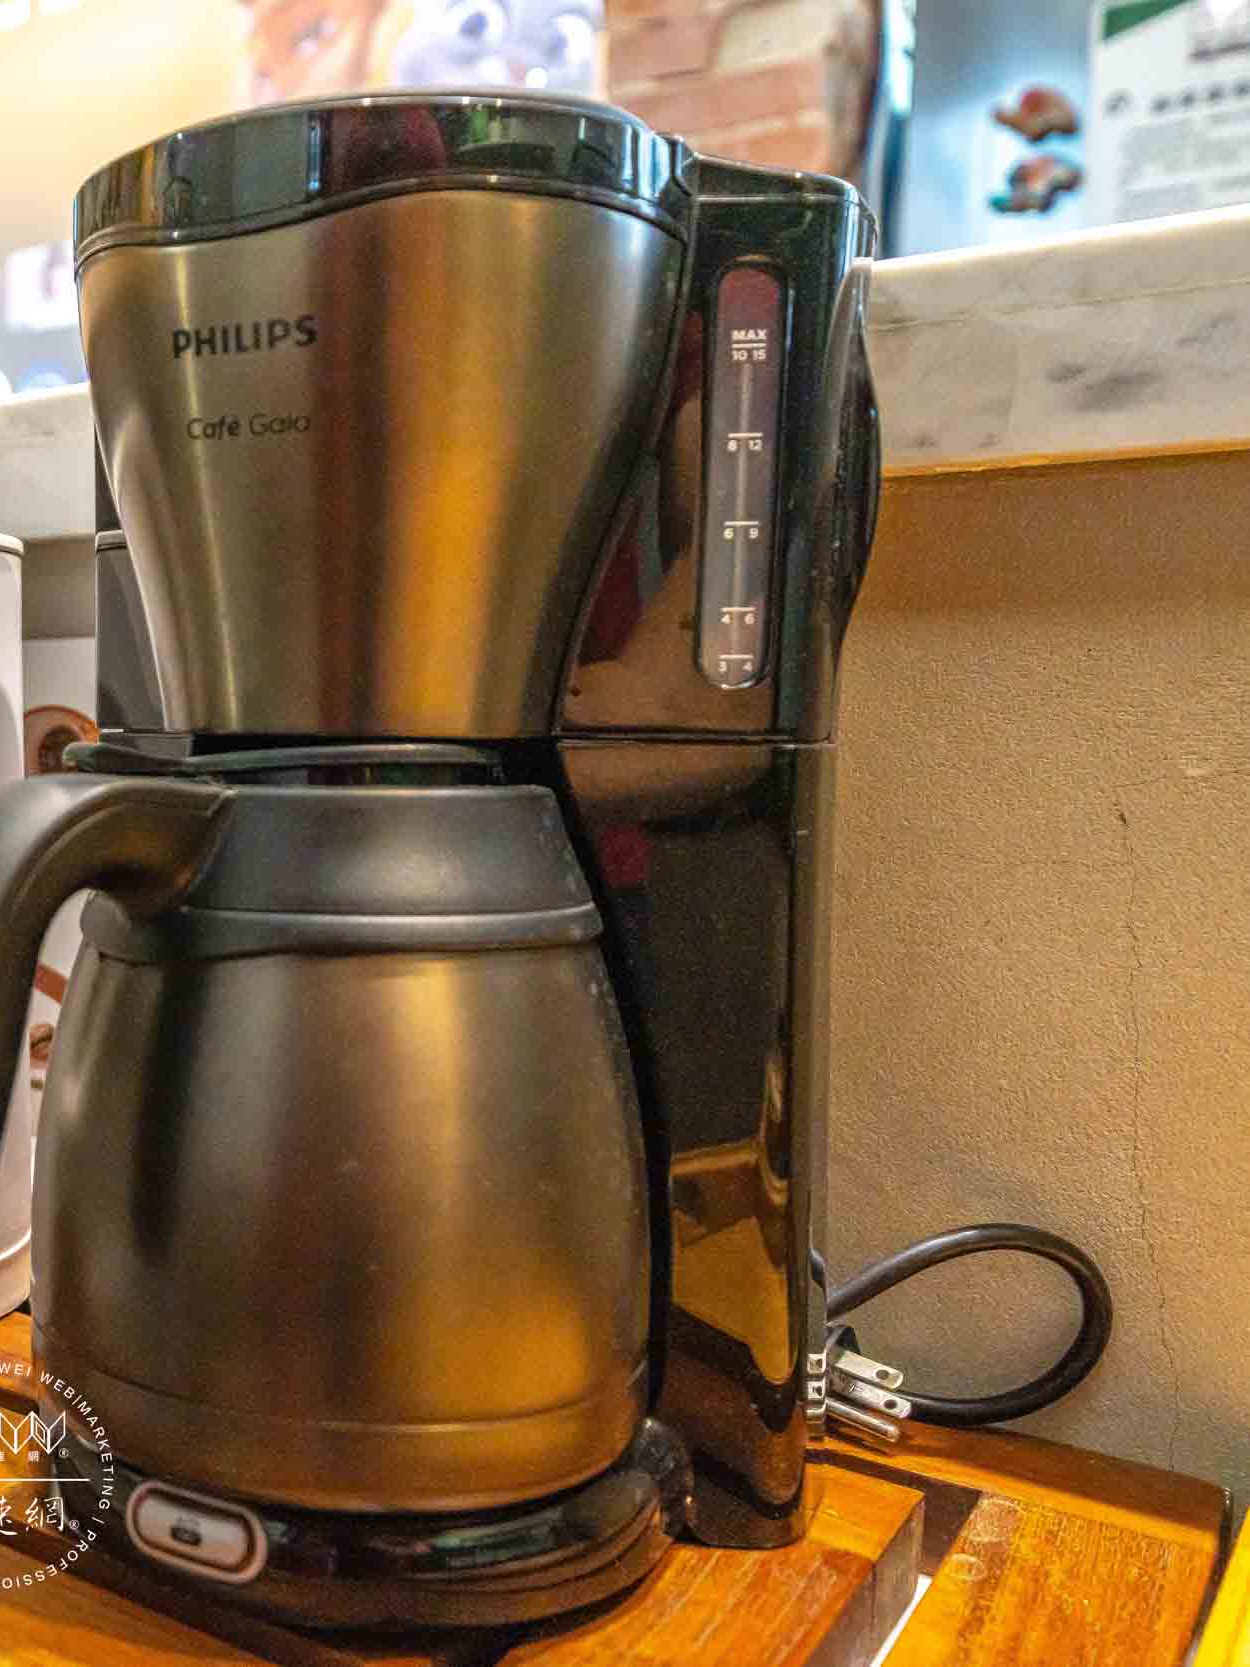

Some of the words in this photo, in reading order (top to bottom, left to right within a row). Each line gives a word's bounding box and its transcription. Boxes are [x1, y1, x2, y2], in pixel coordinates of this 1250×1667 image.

[173, 314, 318, 358] PHILIPS
[732, 329, 766, 340] MAX
[732, 350, 748, 361] 10
[752, 350, 767, 361] 15
[188, 414, 240, 440] Café
[721, 613, 731, 625] 4
